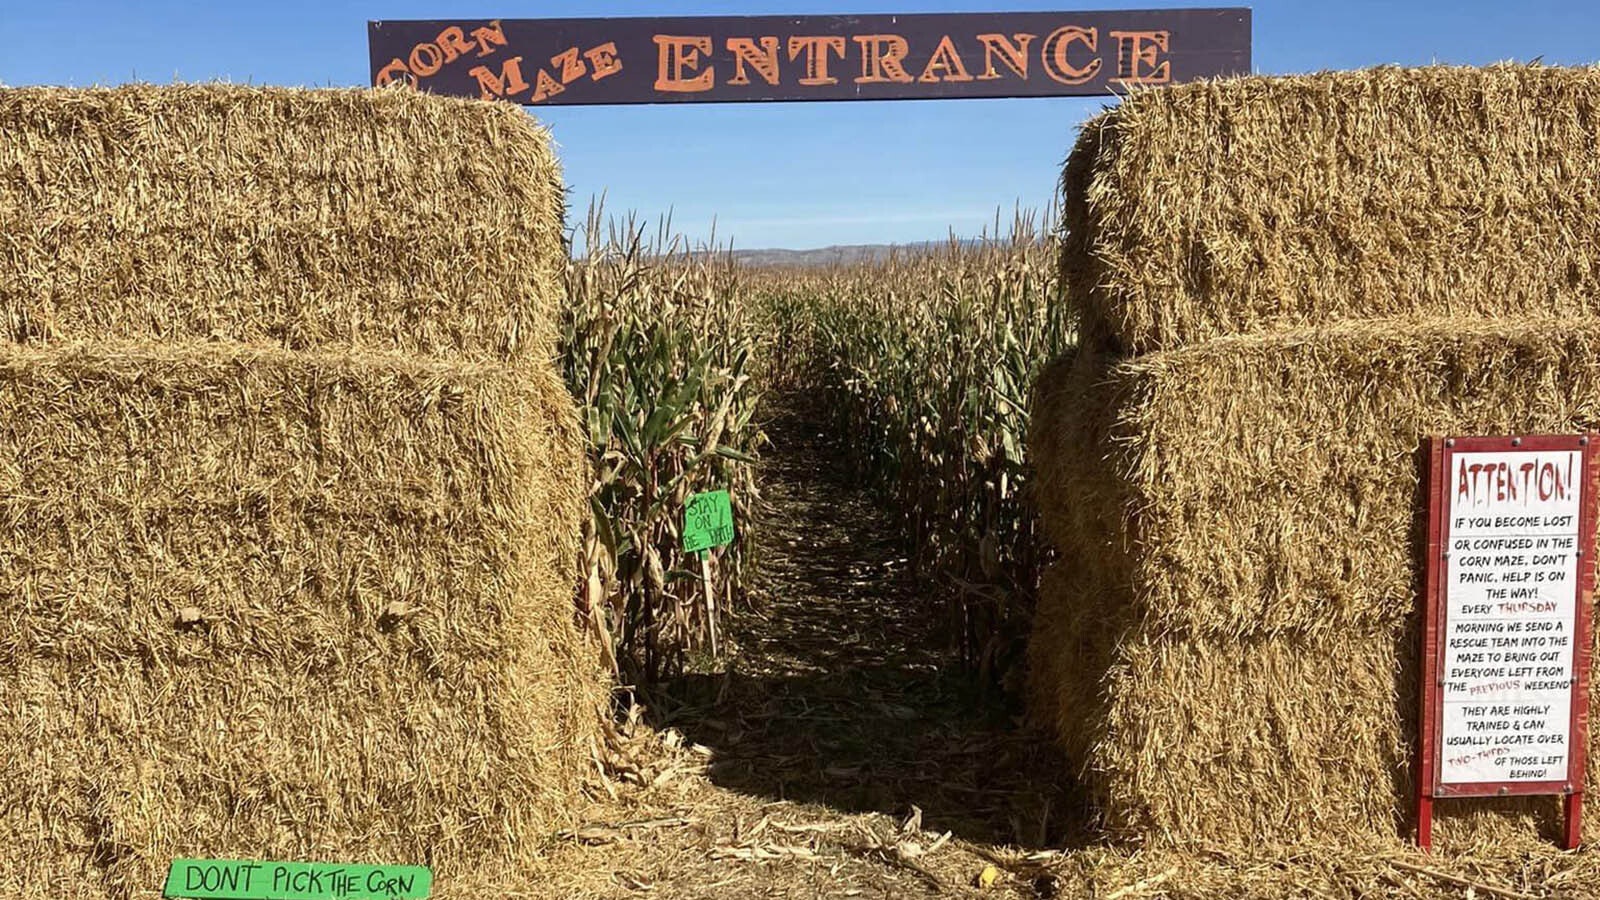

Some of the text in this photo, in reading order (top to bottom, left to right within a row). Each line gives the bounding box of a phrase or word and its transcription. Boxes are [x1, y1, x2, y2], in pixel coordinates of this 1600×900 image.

[376, 20, 508, 90] CORN
[652, 26, 1170, 92] ENTRANCE
[469, 42, 622, 102] MAZE
[1458, 453, 1573, 508] ATTENTION!
[695, 515, 712, 529] ON
[1455, 515, 1573, 528] IF YOU BECOME LOST
[1455, 538, 1573, 551] OR CONFUSED IN THE
[1459, 556, 1491, 567] CORN
[1533, 555, 1567, 566] DON'T
[1502, 572, 1530, 582] HELP
[1535, 572, 1544, 582] IS
[1548, 572, 1565, 582] ON
[1486, 588, 1538, 600] THE WAY!
[1462, 602, 1557, 614] EVERY THURSDAY
[1456, 622, 1563, 633] MORNING WE SEND A
[1450, 637, 1567, 648] RESCUE TEAM INTO THE
[1457, 652, 1560, 663] MAZE TO BRING OUT
[1452, 667, 1563, 678] EVERYONE LEFT FROM
[1448, 682, 1467, 691] THE
[1525, 681, 1569, 690] WEEKEND
[1462, 705, 1550, 717] THEY ARE HIGHLY
[1467, 720, 1544, 731] TRAINED & CAN
[1447, 735, 1564, 746] USUALLY LOCATE OVER
[1494, 756, 1563, 766] OF THOSE LEFT
[1510, 769, 1547, 778] BEHIND!
[273, 866, 323, 893] PICK
[325, 869, 361, 896] THE
